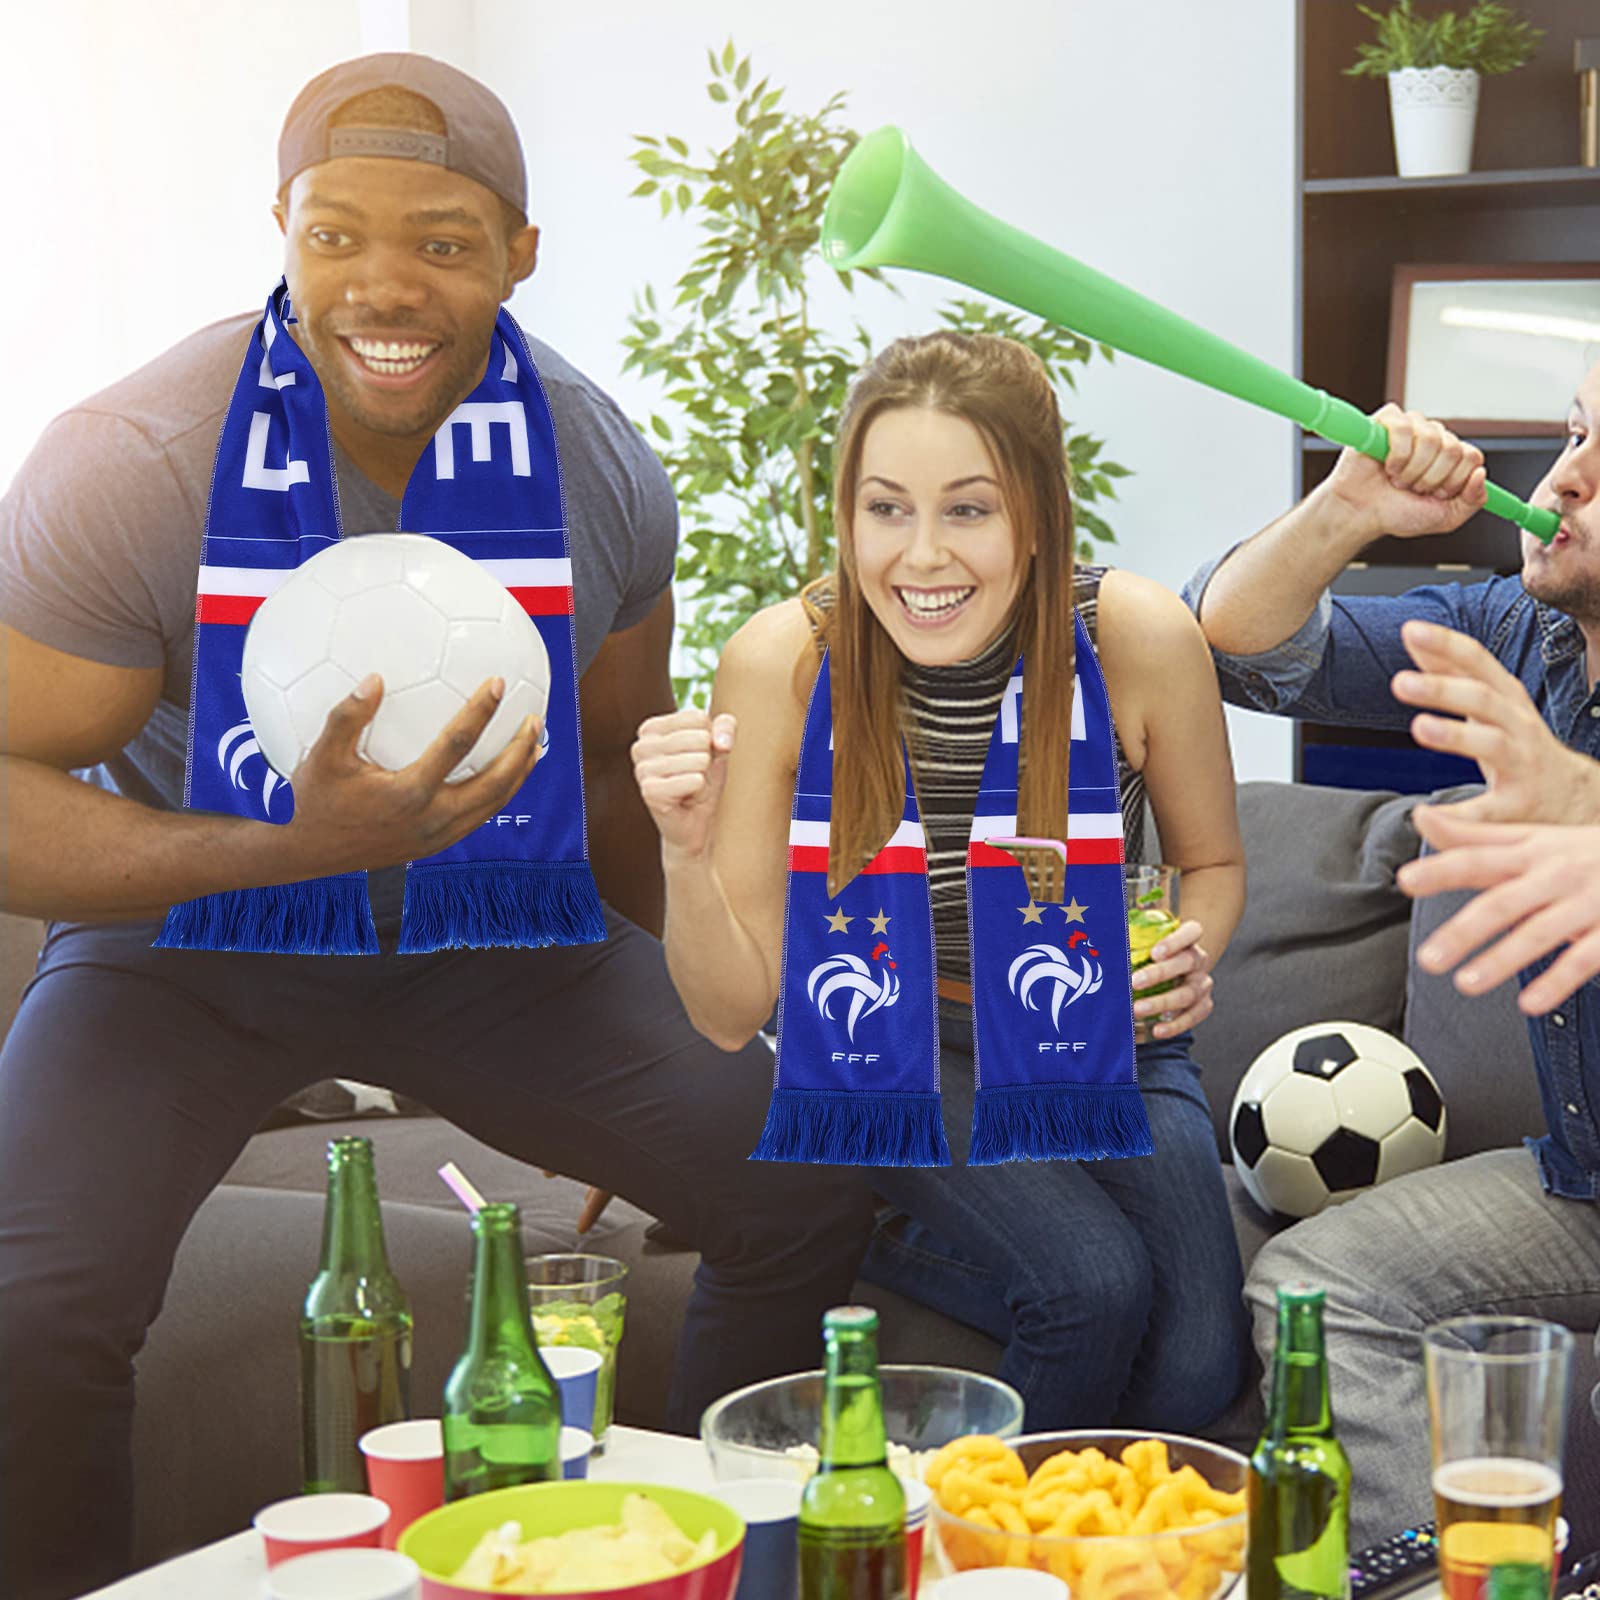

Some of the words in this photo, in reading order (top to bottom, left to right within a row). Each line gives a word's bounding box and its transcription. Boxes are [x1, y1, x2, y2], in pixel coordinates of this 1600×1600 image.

[484, 815, 532, 827] FF
[1038, 1042, 1087, 1053] FFF
[831, 1052, 880, 1064] FFF
